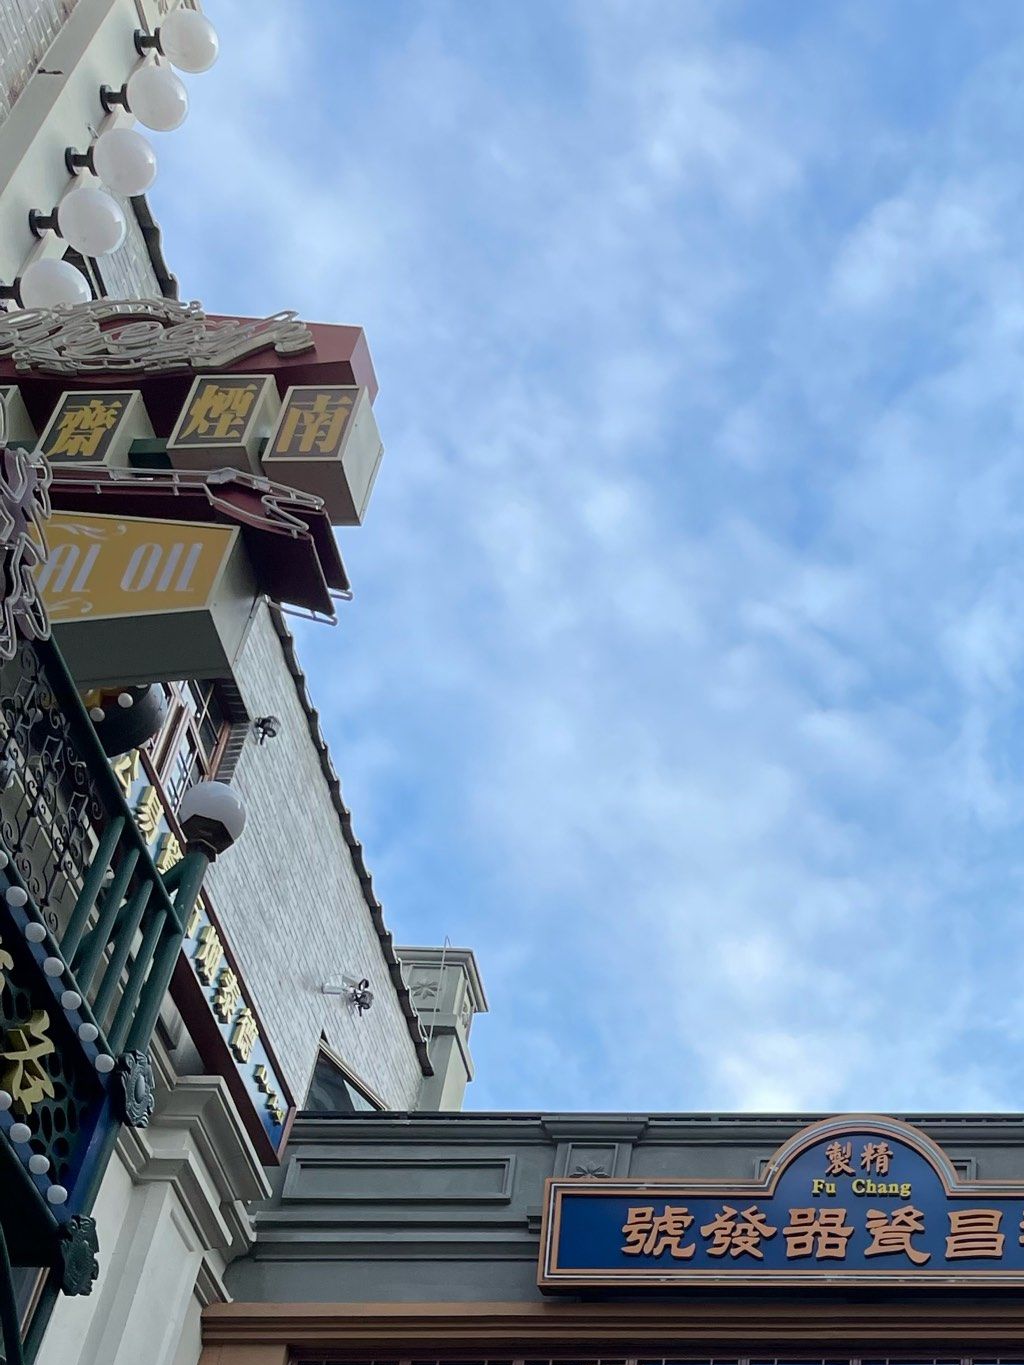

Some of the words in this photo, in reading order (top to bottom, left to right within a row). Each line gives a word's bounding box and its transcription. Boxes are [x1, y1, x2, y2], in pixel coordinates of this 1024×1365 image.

[120, 543, 203, 593] OIL
[812, 1179, 837, 1196] Fu
[852, 1178, 913, 1198] Chang
